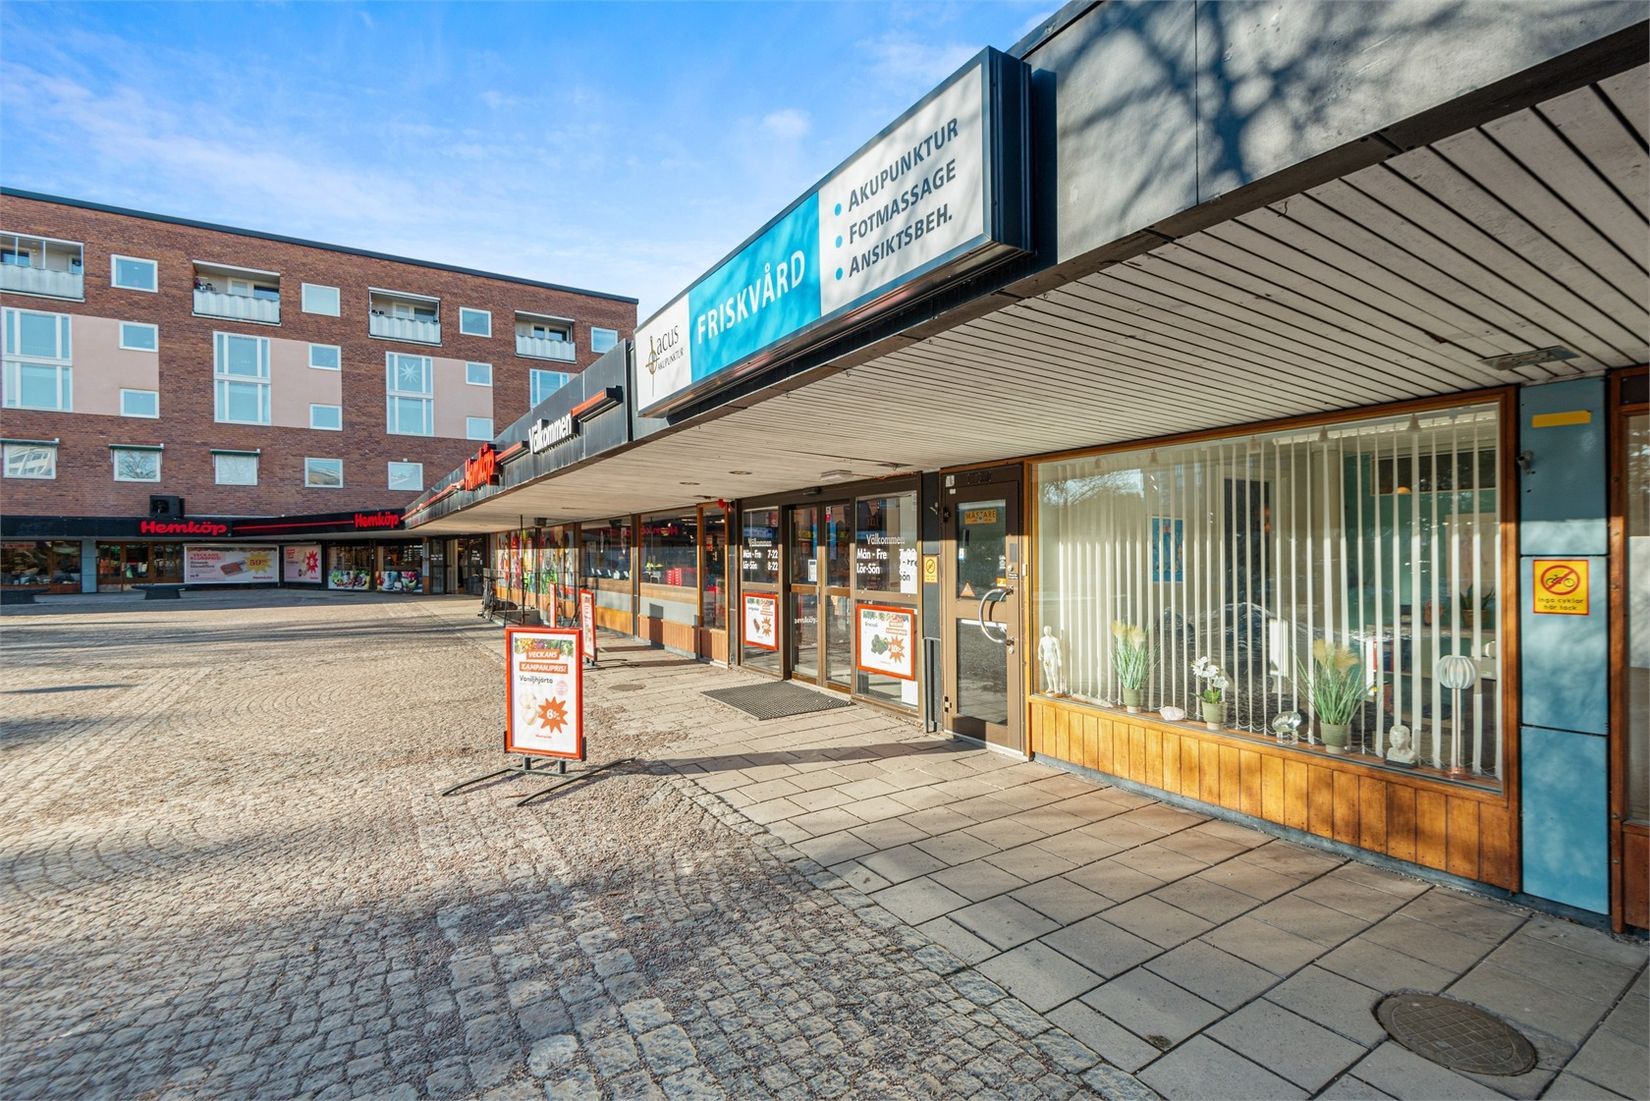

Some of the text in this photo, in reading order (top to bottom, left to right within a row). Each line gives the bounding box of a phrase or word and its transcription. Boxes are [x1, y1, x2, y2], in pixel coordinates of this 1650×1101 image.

[848, 118, 958, 212] AKUPUNKTUR
[849, 158, 956, 244] FOTMASSAGE
[848, 203, 953, 278] ANSIKTSBEH.
[697, 250, 805, 345] FRISKVÅRD
[528, 413, 572, 455] Välkommen
[140, 521, 227, 536] Hemköp
[354, 511, 399, 528] Hemköp
[866, 533, 906, 545] Välkommen
[856, 548, 871, 559] Mån
[876, 548, 887, 560] Fre
